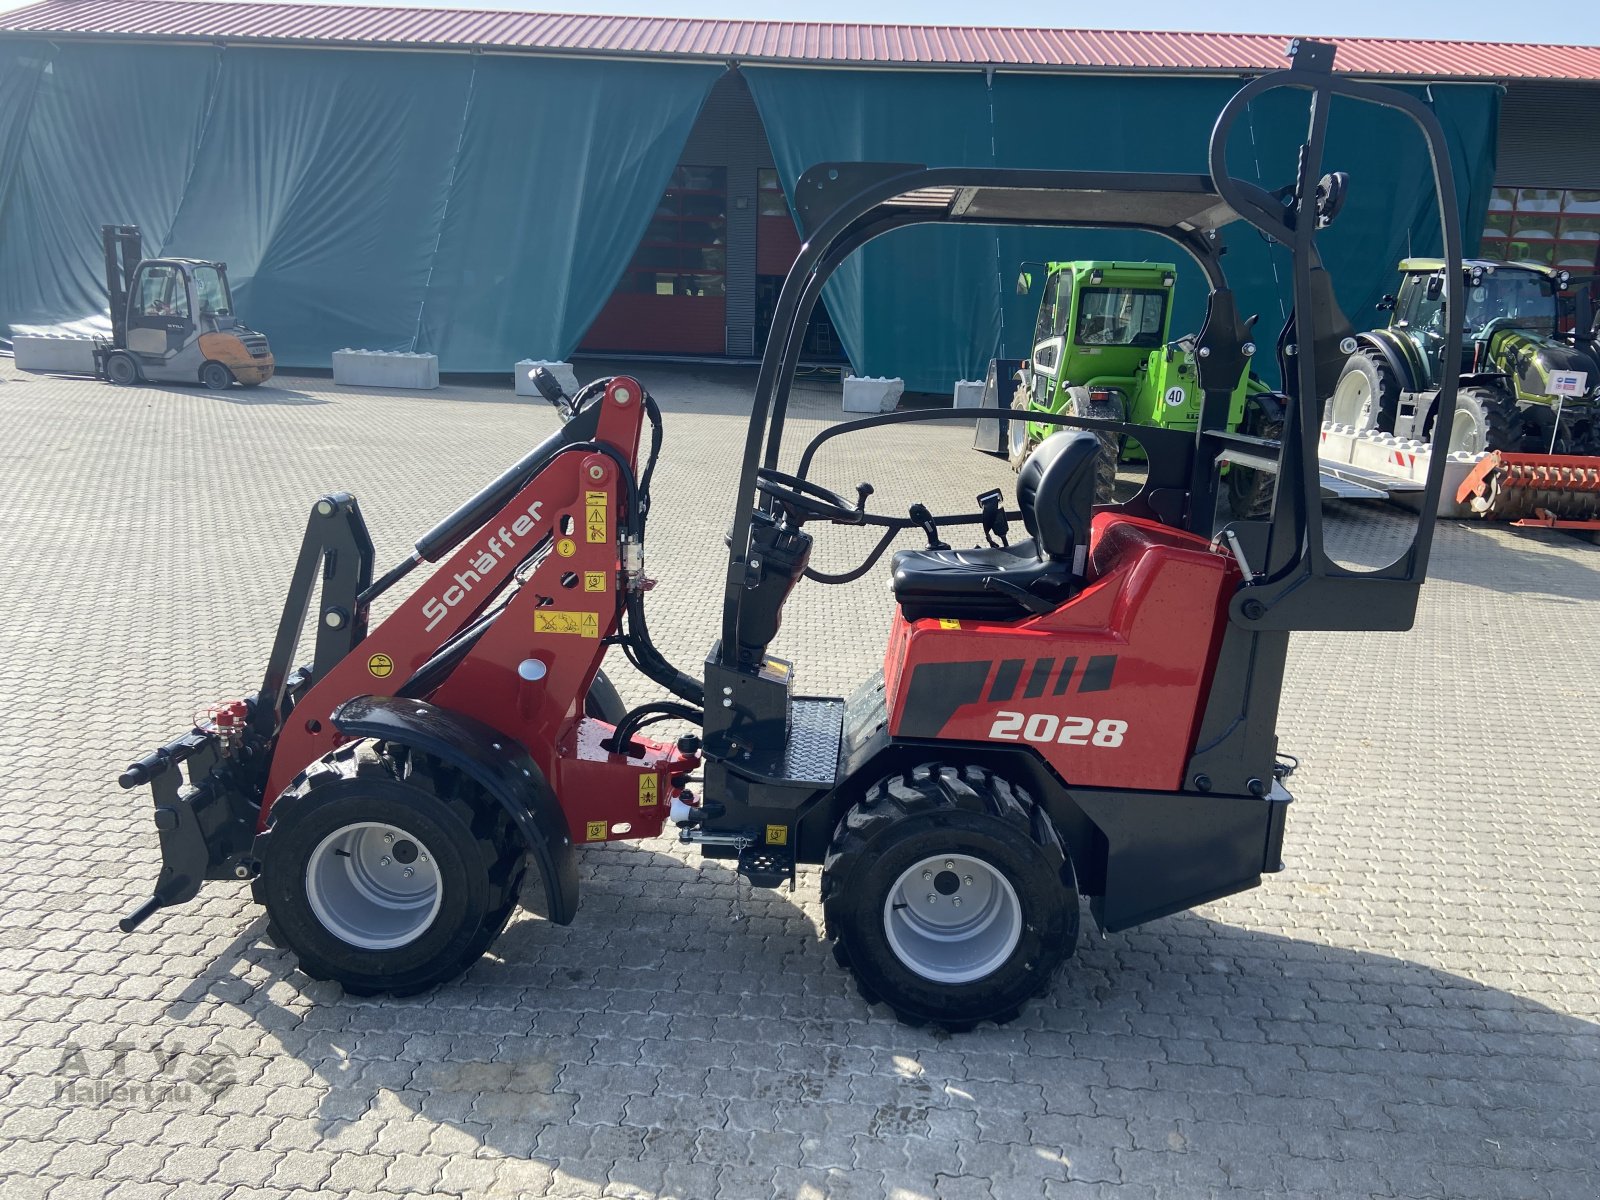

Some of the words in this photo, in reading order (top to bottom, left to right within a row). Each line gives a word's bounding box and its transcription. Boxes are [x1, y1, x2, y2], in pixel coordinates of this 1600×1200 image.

[1168, 390, 1182, 403] 40
[422, 500, 543, 632] Schäffer
[988, 710, 1129, 748] 2028
